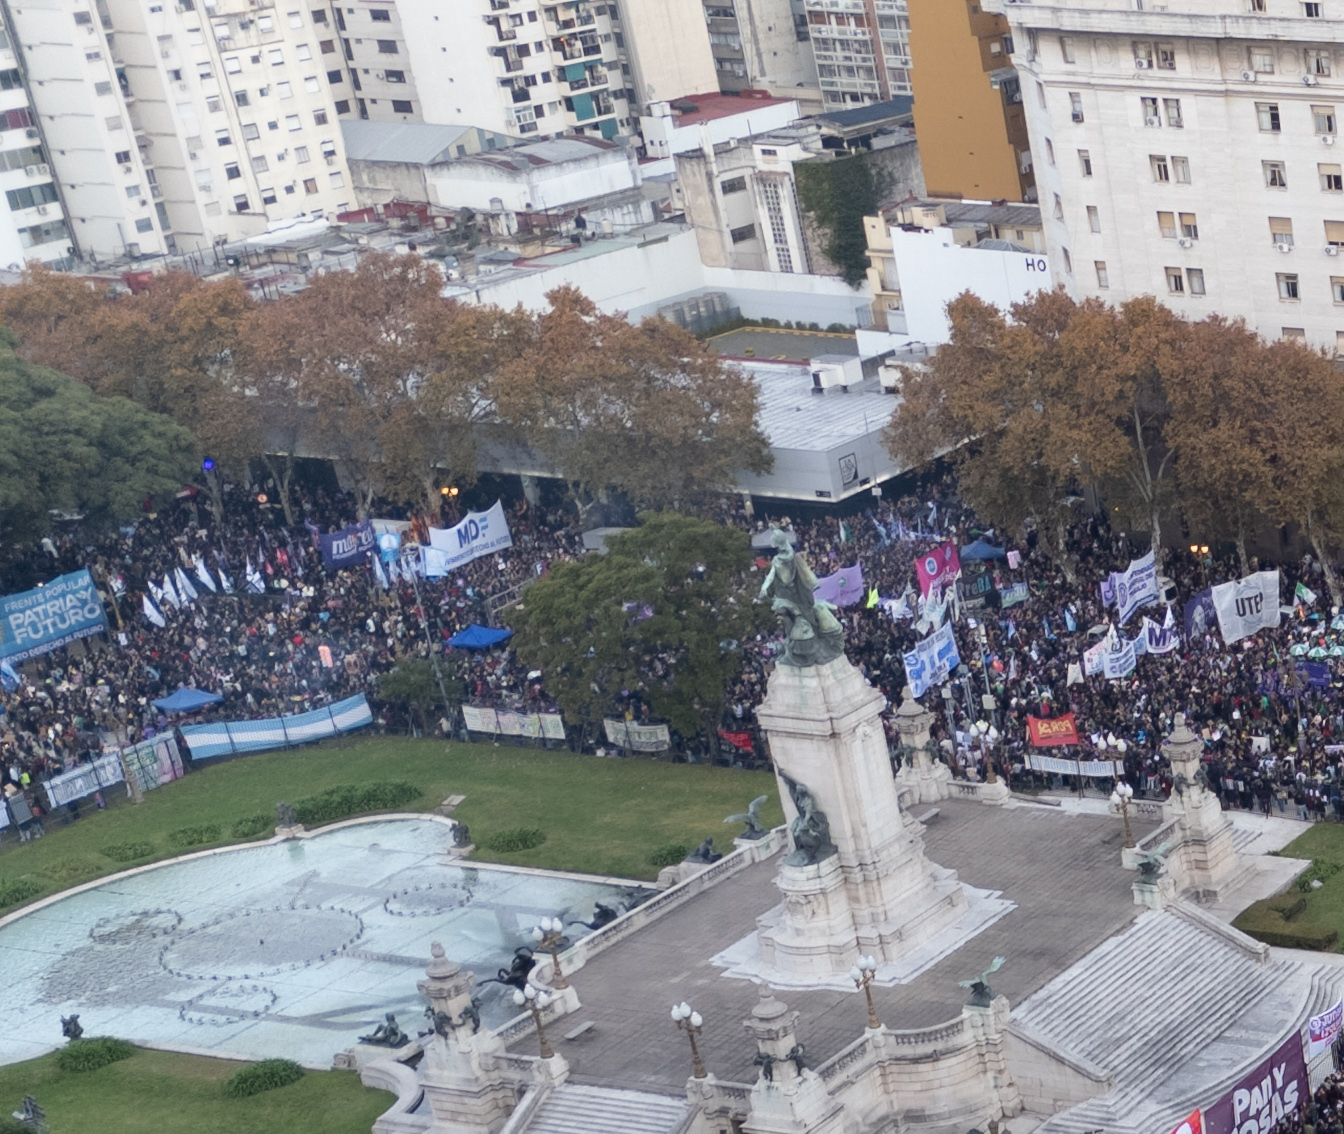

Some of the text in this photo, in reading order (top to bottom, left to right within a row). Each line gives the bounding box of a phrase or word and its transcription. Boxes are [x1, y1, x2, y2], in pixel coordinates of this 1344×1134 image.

[4, 575, 91, 613] FRENTE POPULAR
[9, 594, 78, 629] PATRIA
[13, 602, 100, 644] FUTURO
[3, 652, 28, 664] ENTO
[29, 638, 65, 659] DERECHO
[74, 624, 104, 640] FUTURO
[1273, 1062, 1286, 1089] Y
